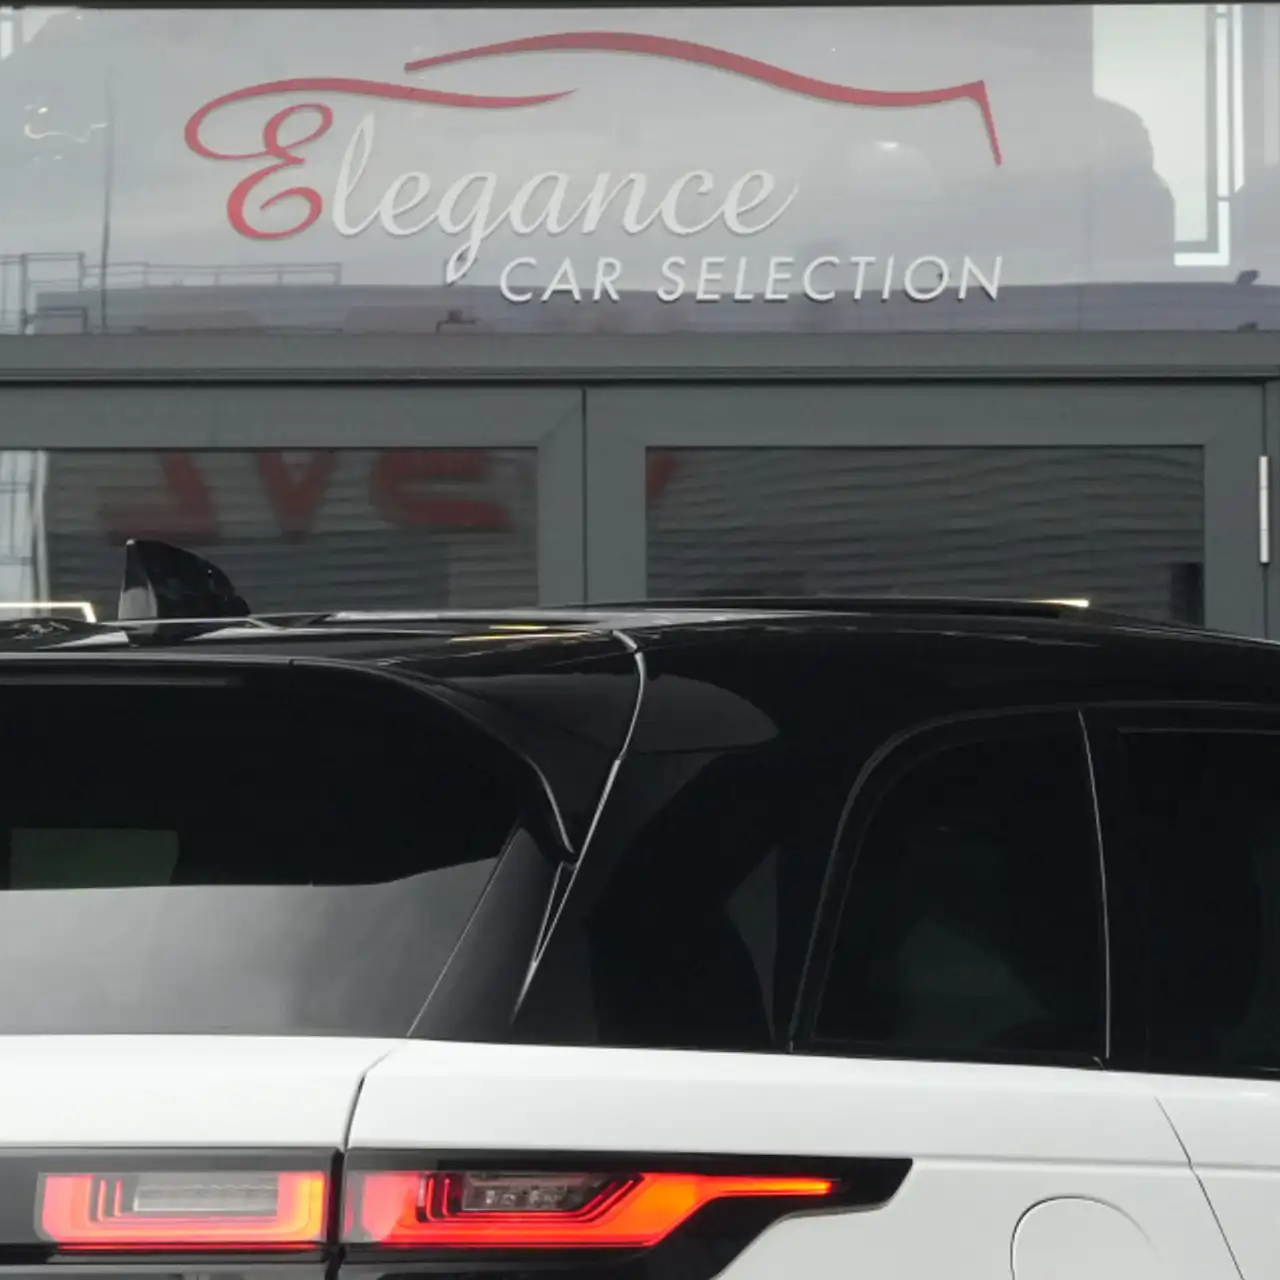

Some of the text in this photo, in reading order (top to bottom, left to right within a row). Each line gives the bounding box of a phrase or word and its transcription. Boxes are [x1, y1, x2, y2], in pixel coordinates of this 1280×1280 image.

[184, 78, 798, 284] Elegance
[498, 254, 1004, 304] CAR SELECTION
